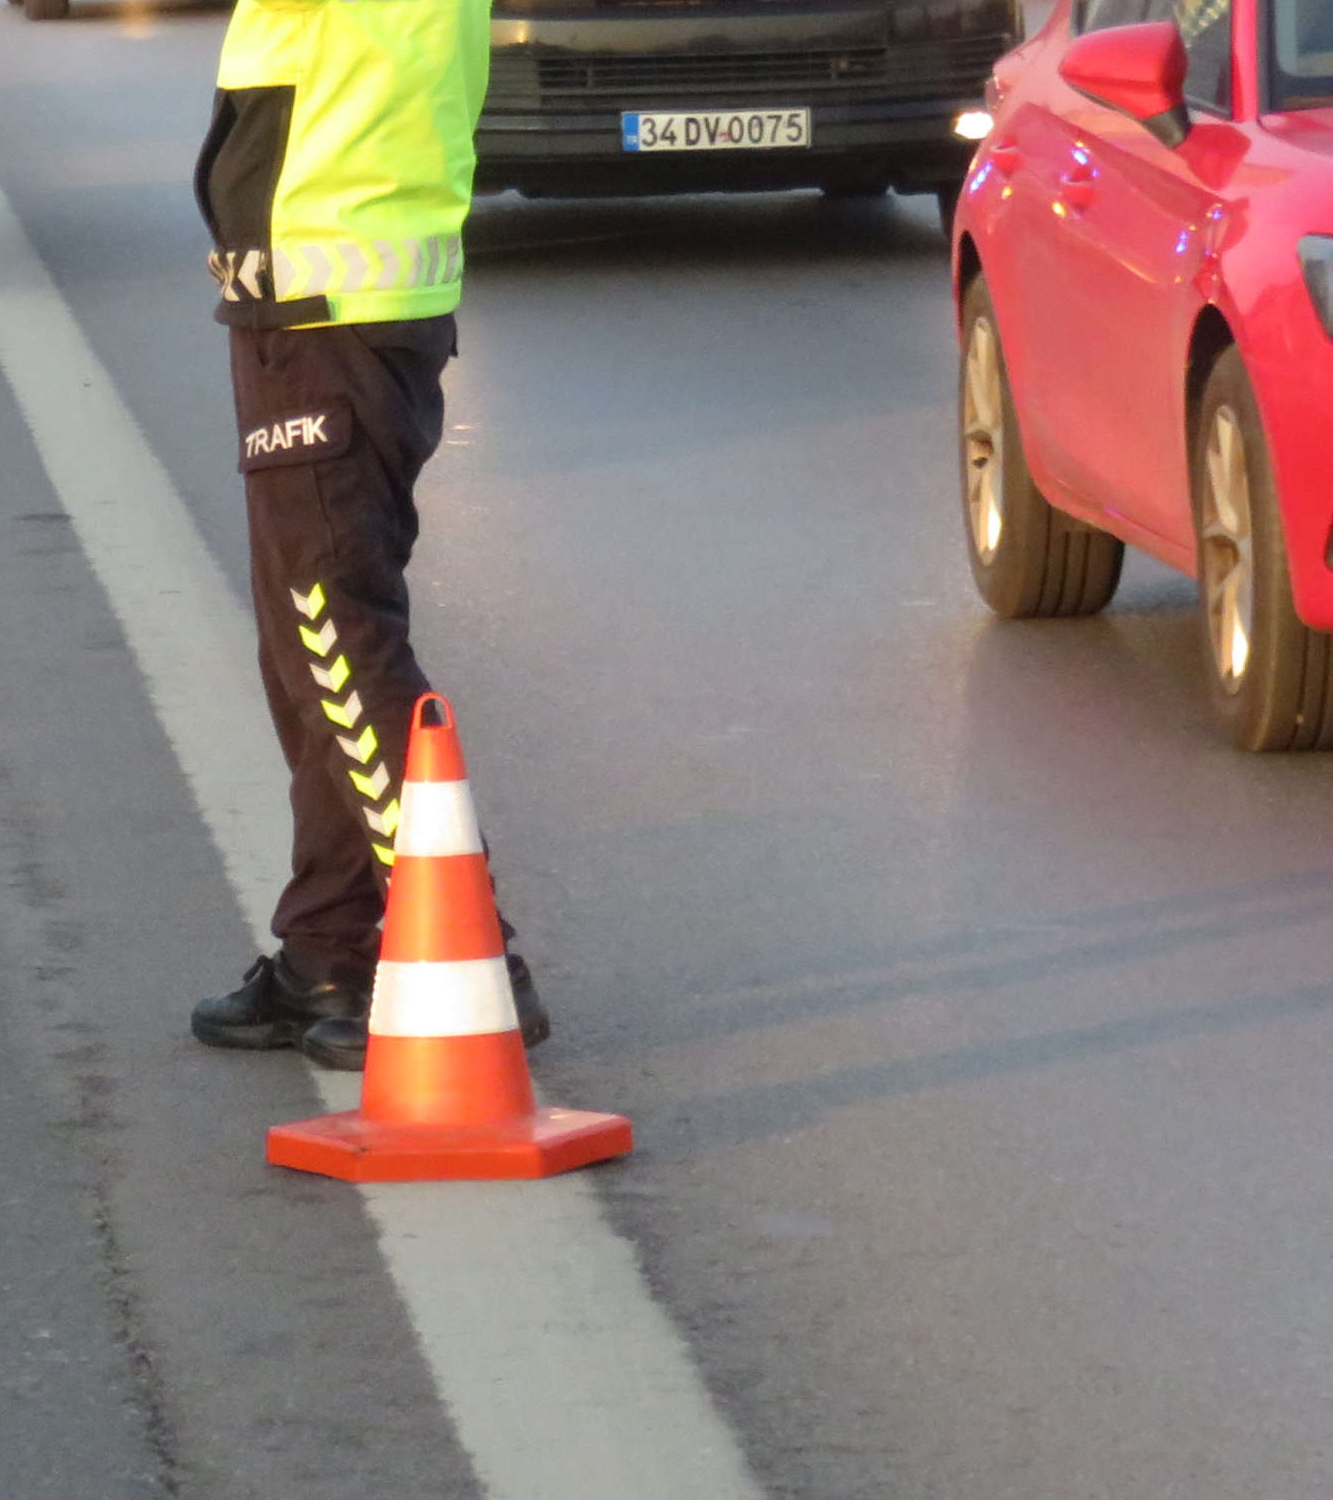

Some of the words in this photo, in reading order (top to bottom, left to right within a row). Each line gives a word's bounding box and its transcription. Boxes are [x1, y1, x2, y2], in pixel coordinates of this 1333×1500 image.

[641, 117, 677, 147] 34
[685, 117, 720, 147] DV
[728, 113, 803, 143] 0075
